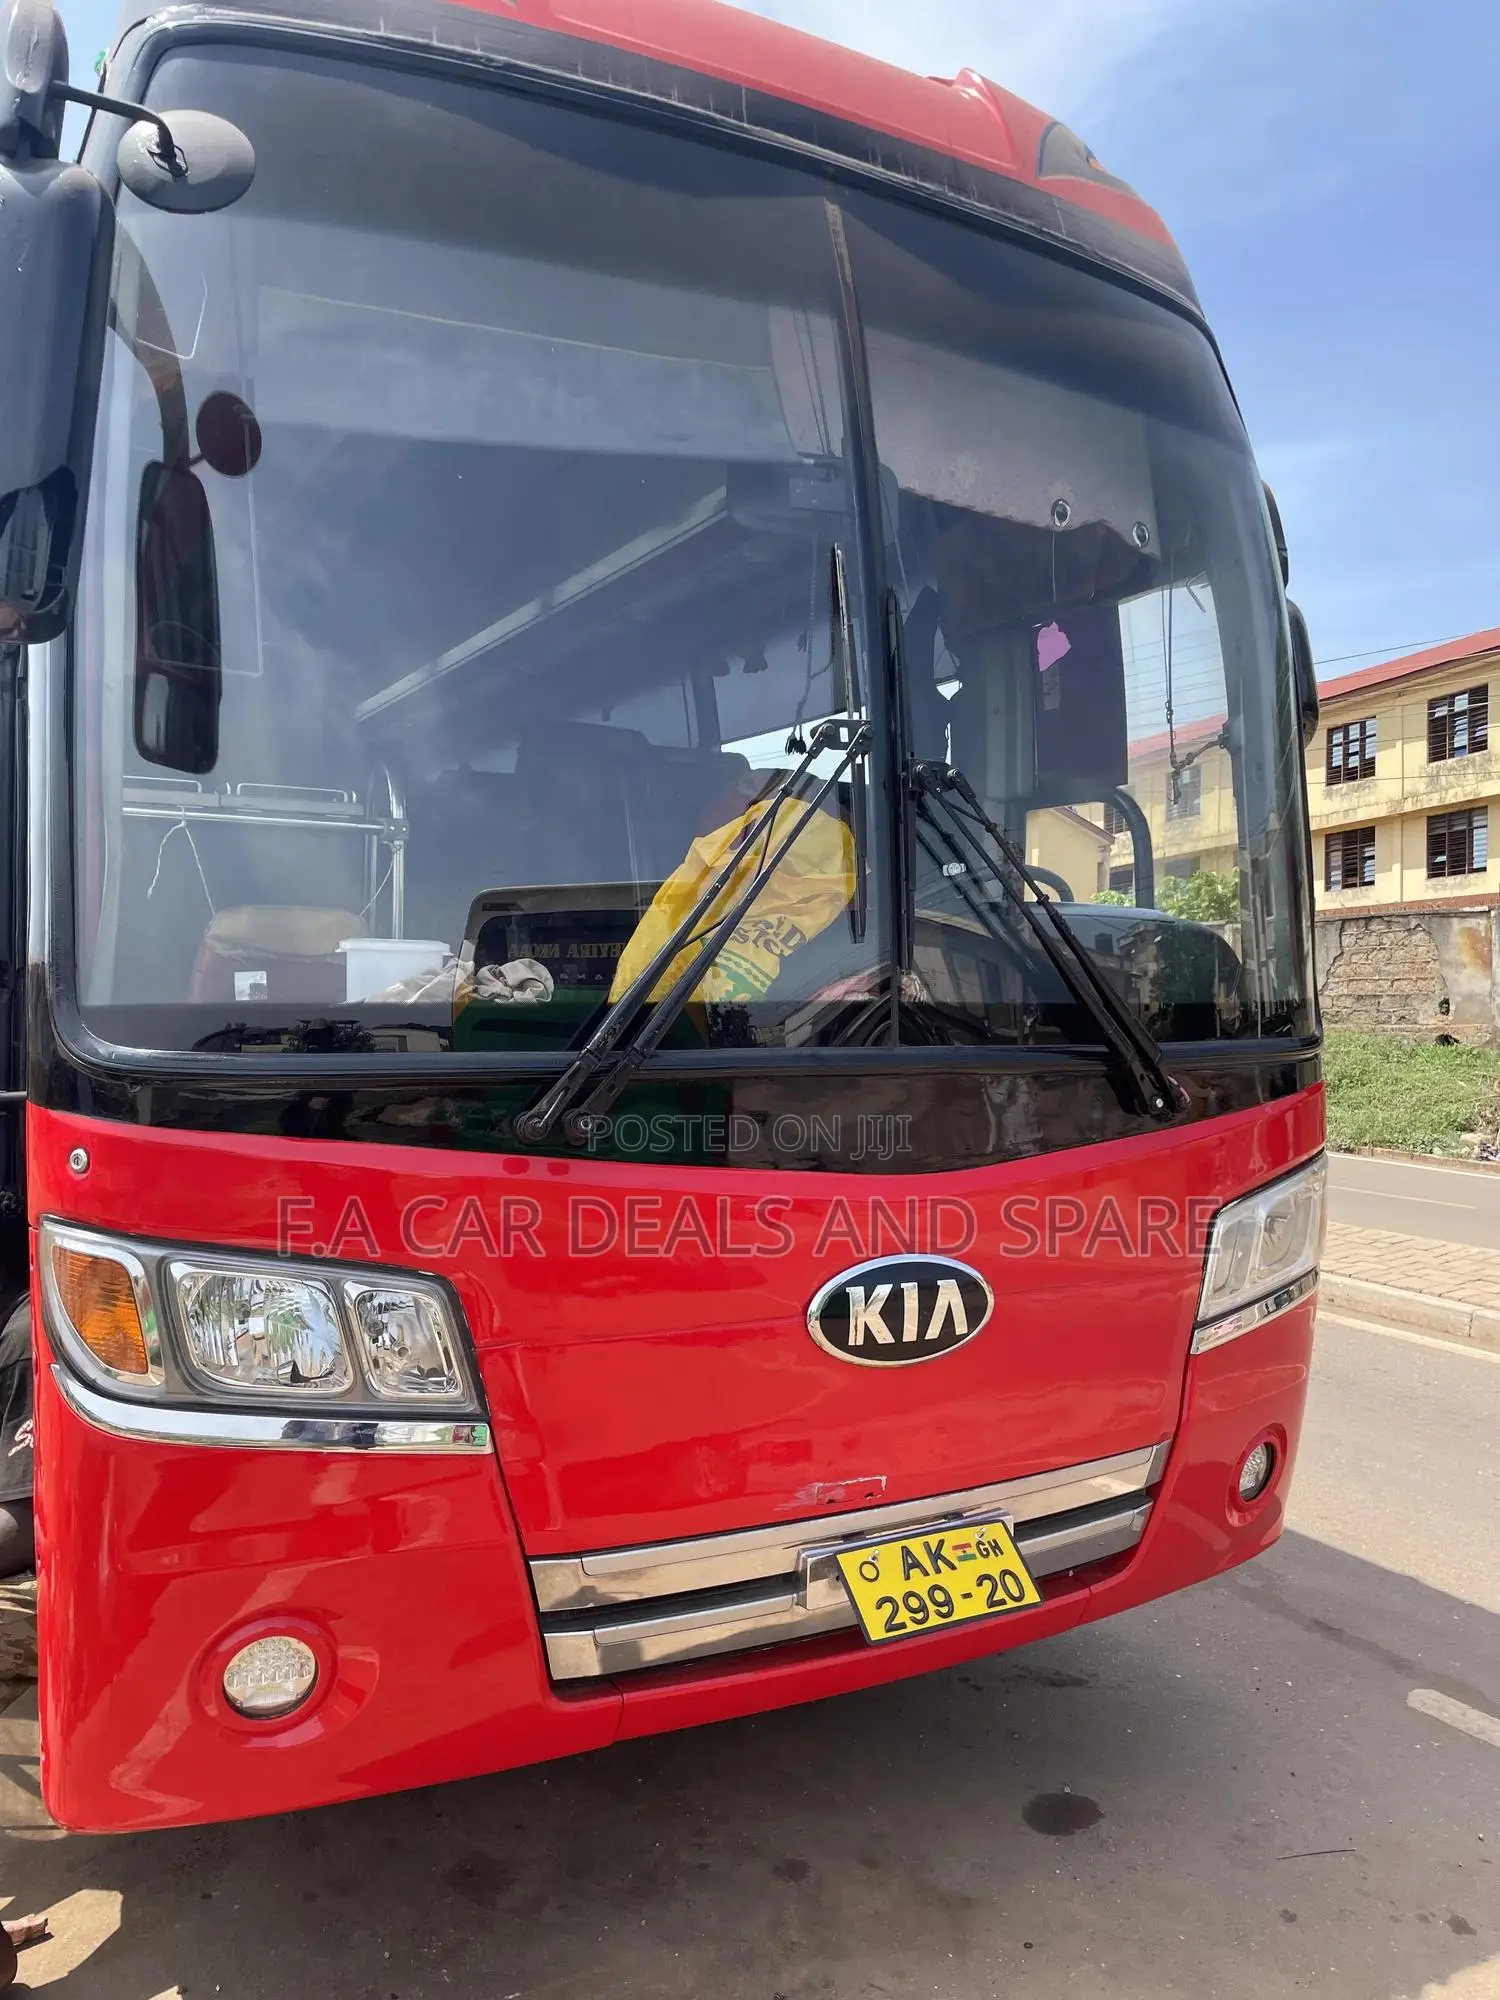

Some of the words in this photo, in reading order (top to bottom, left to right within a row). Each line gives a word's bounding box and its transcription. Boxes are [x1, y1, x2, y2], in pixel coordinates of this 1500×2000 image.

[845, 1279, 969, 1346] KIA
[901, 1538, 958, 1582] AK
[975, 1538, 1004, 1560] GH
